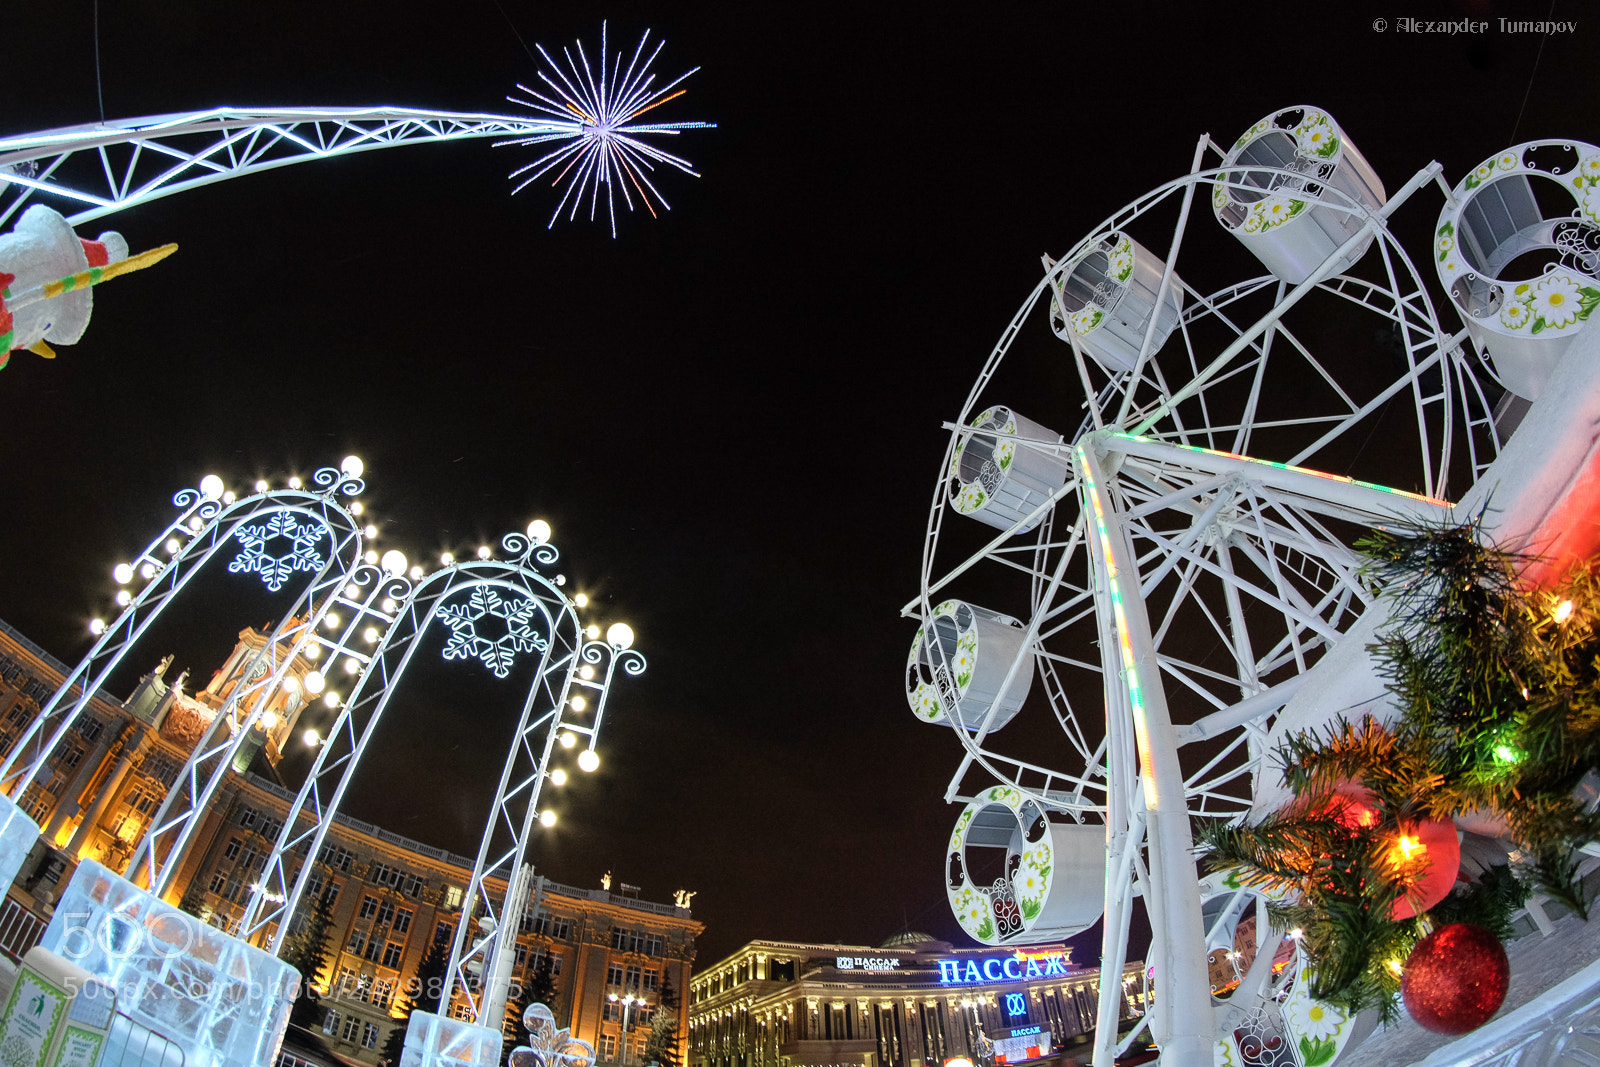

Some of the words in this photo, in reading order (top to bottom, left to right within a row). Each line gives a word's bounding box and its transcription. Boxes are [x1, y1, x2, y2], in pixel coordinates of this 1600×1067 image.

[854, 957, 900, 967] ПАССАЖ
[938, 956, 1067, 983] ПАССАЖ
[1011, 1026, 1041, 1037] ПАССАЖ
